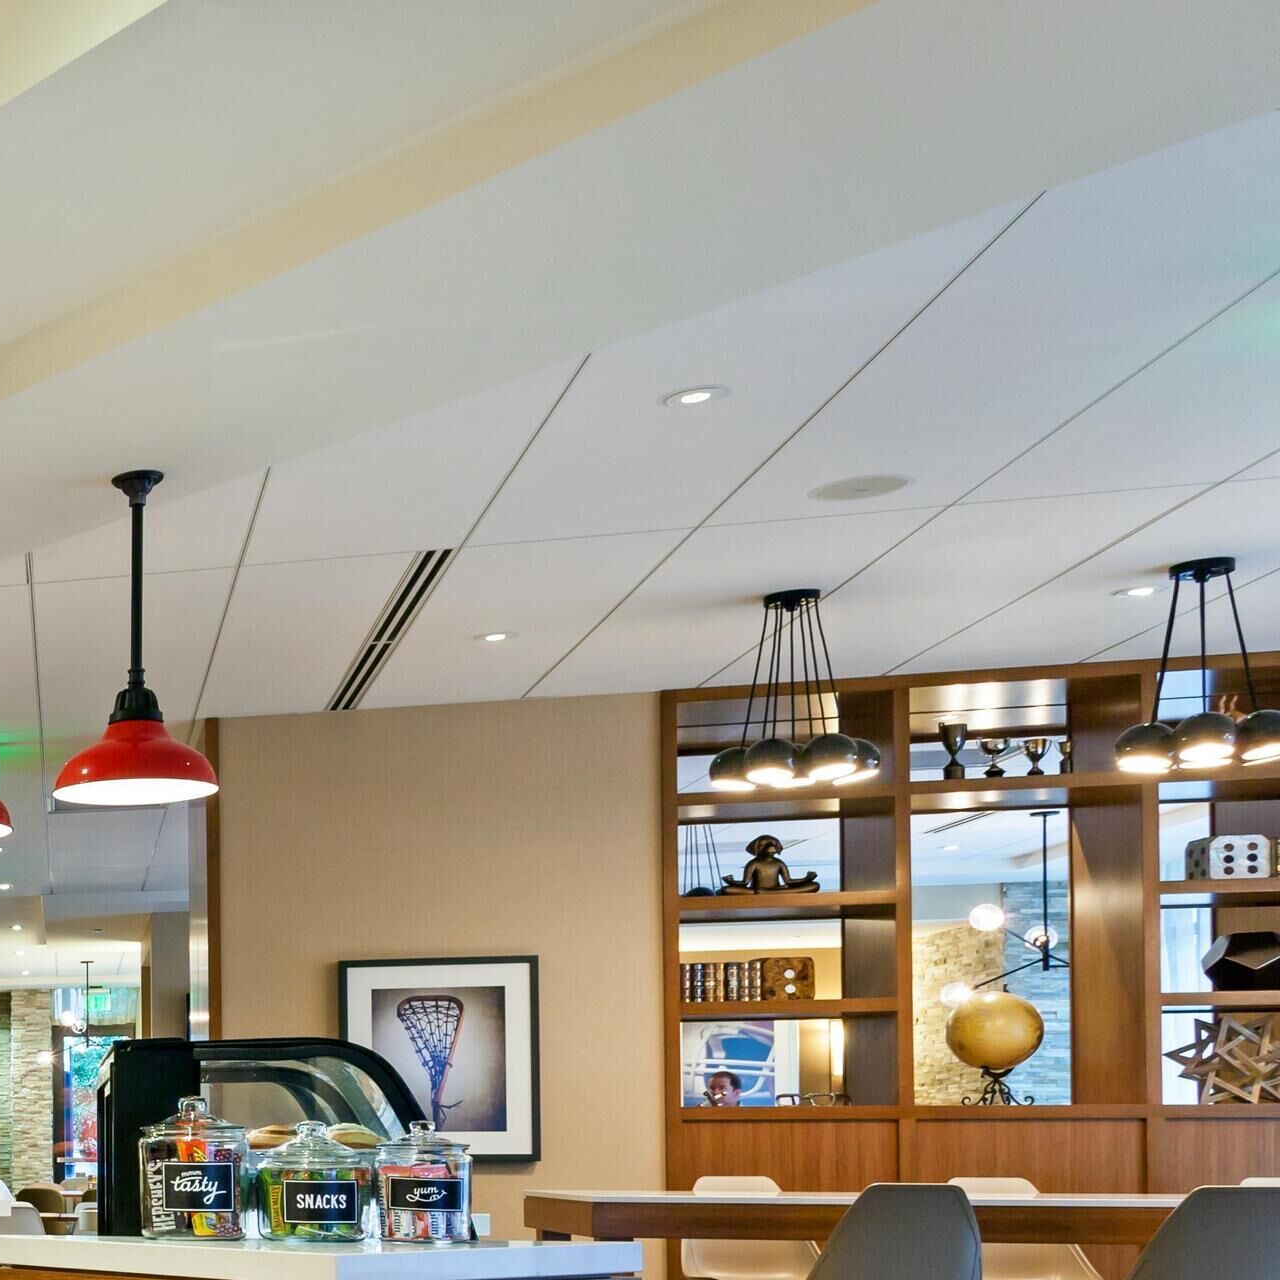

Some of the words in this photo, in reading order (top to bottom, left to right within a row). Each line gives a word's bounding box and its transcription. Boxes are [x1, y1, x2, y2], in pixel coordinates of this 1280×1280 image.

[170, 1176, 227, 1205] tasty
[407, 1186, 441, 1202] yum
[296, 1193, 347, 1209] SNACKS
